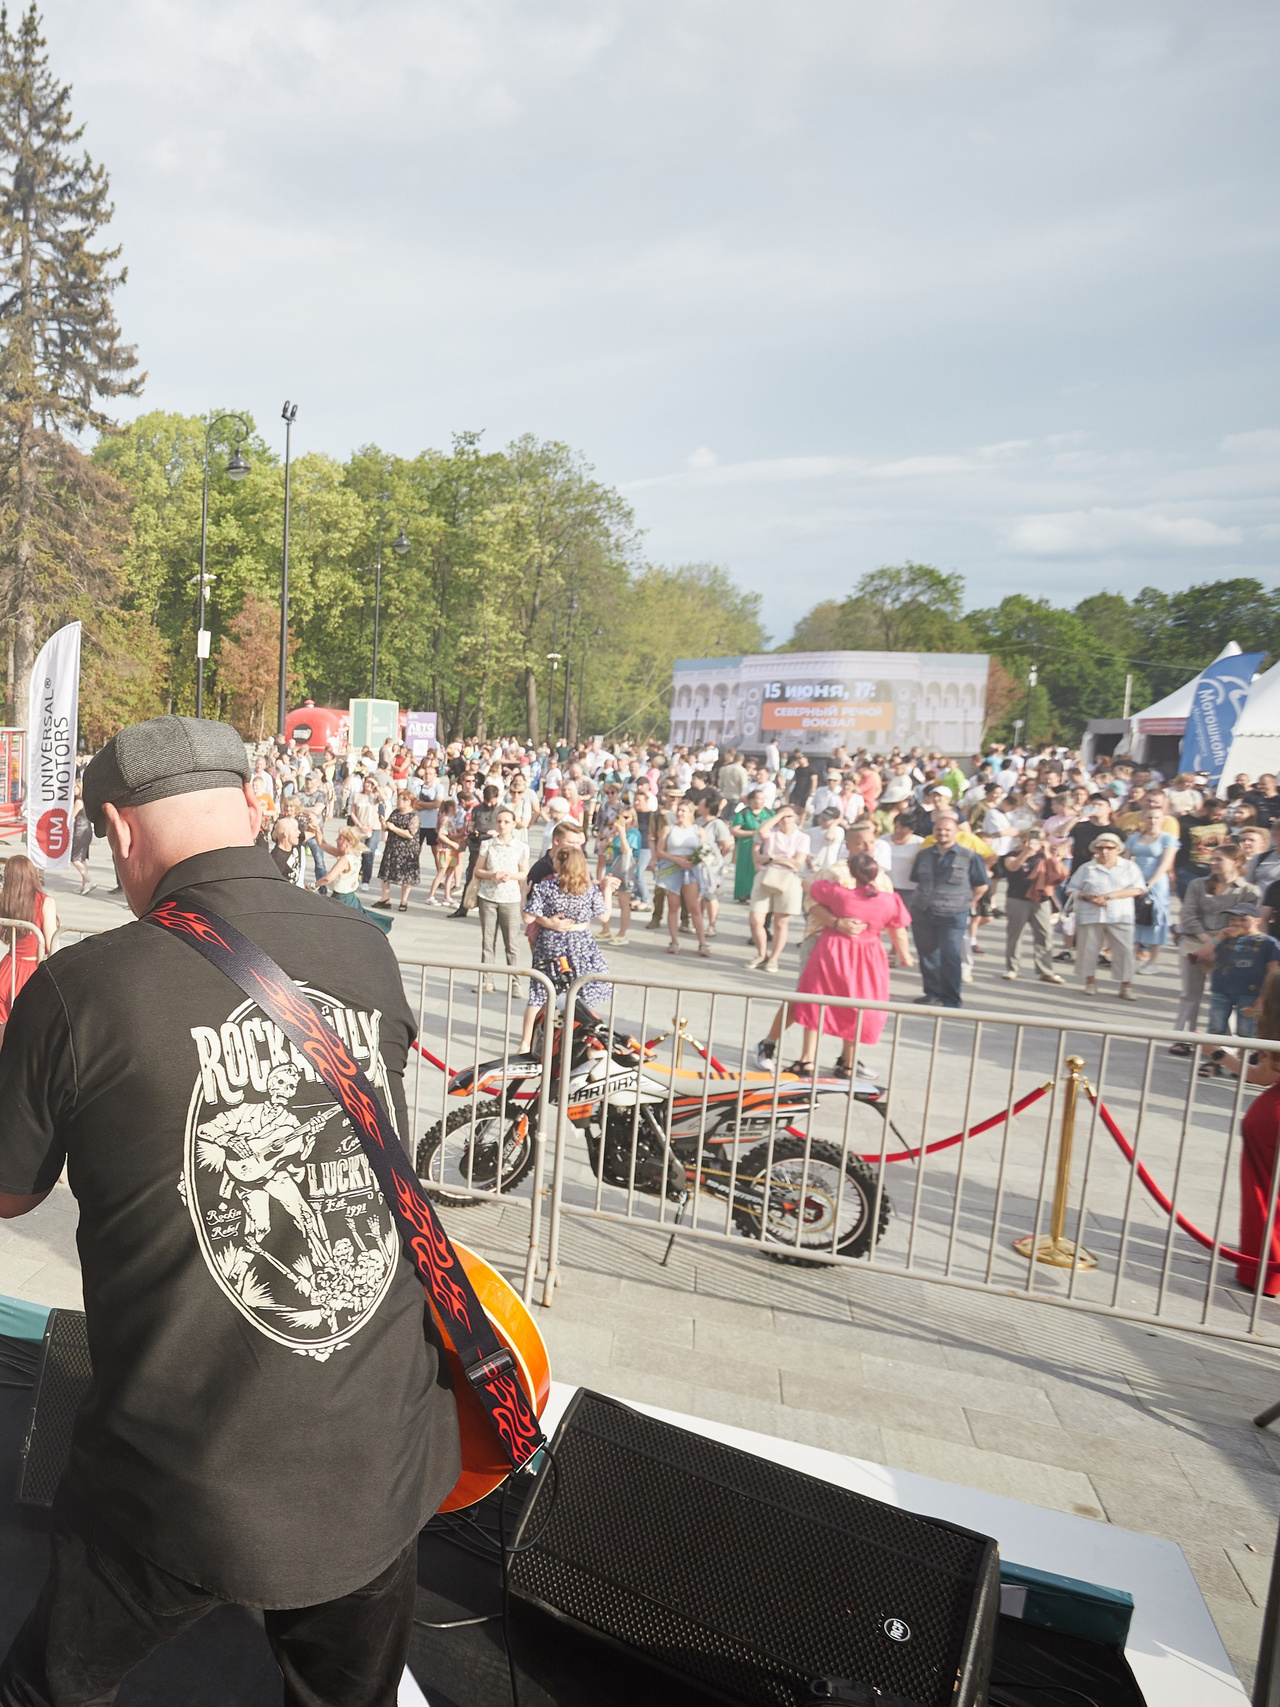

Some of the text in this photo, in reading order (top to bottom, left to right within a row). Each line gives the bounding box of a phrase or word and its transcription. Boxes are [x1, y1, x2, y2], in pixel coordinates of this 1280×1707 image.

[764, 683, 781, 698] 15
[785, 684, 850, 700] июня,
[774, 704, 839, 717] СЕВЕРНЫЙ
[802, 717, 857, 728] ВОКЗАЛ
[54, 717, 70, 801] MOTORS
[49, 816, 64, 850] UM
[190, 1007, 383, 1105] ROCKALLY
[554, 1076, 638, 1105] HARMAX
[306, 1153, 372, 1198] LUCKY
[346, 1203, 368, 1217] 1991
